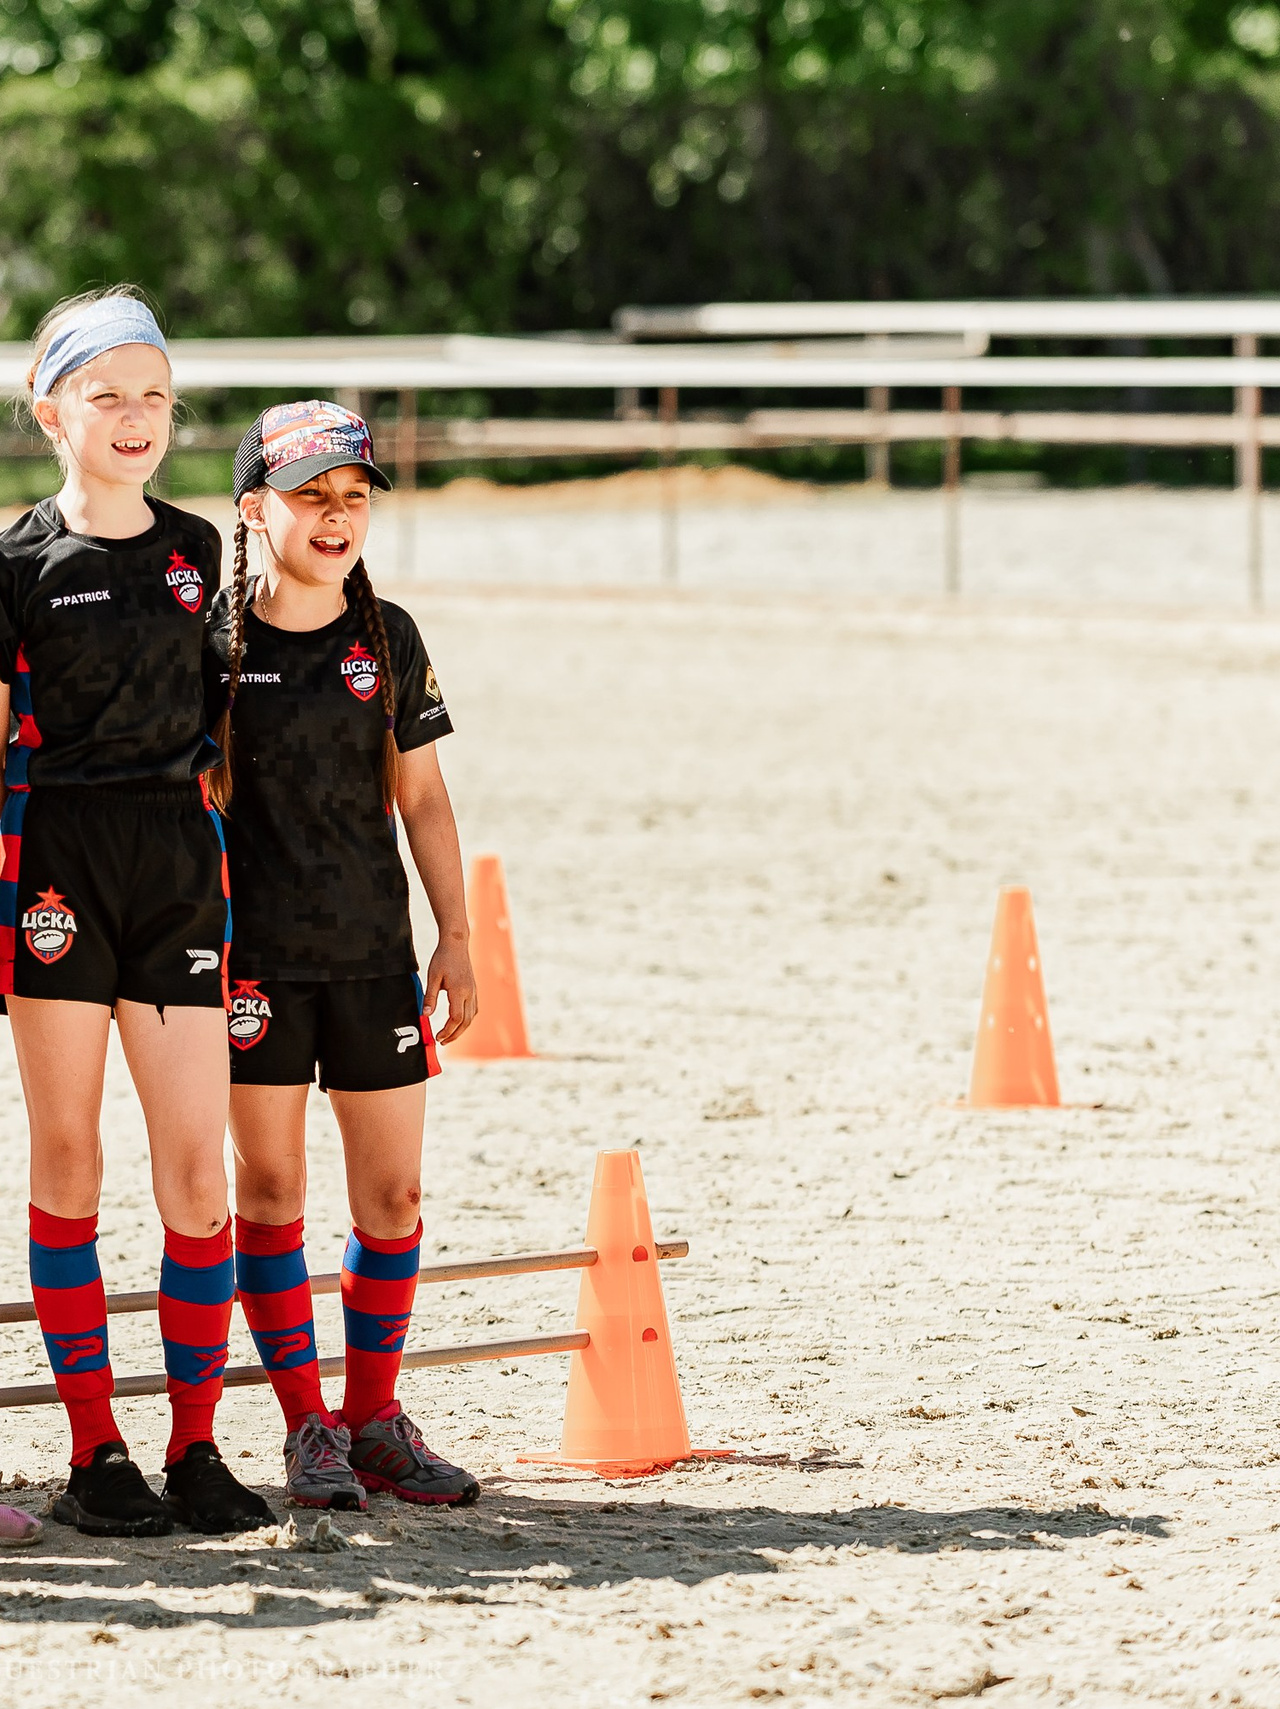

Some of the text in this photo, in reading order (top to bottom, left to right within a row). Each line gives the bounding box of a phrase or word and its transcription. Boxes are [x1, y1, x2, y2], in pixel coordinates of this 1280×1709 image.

[165, 569, 203, 587] ЦСКА
[63, 589, 111, 606] PATRICK
[340, 660, 378, 676] ЦСКА
[238, 673, 281, 684] ATRICK
[21, 911, 78, 933] ЦСКА
